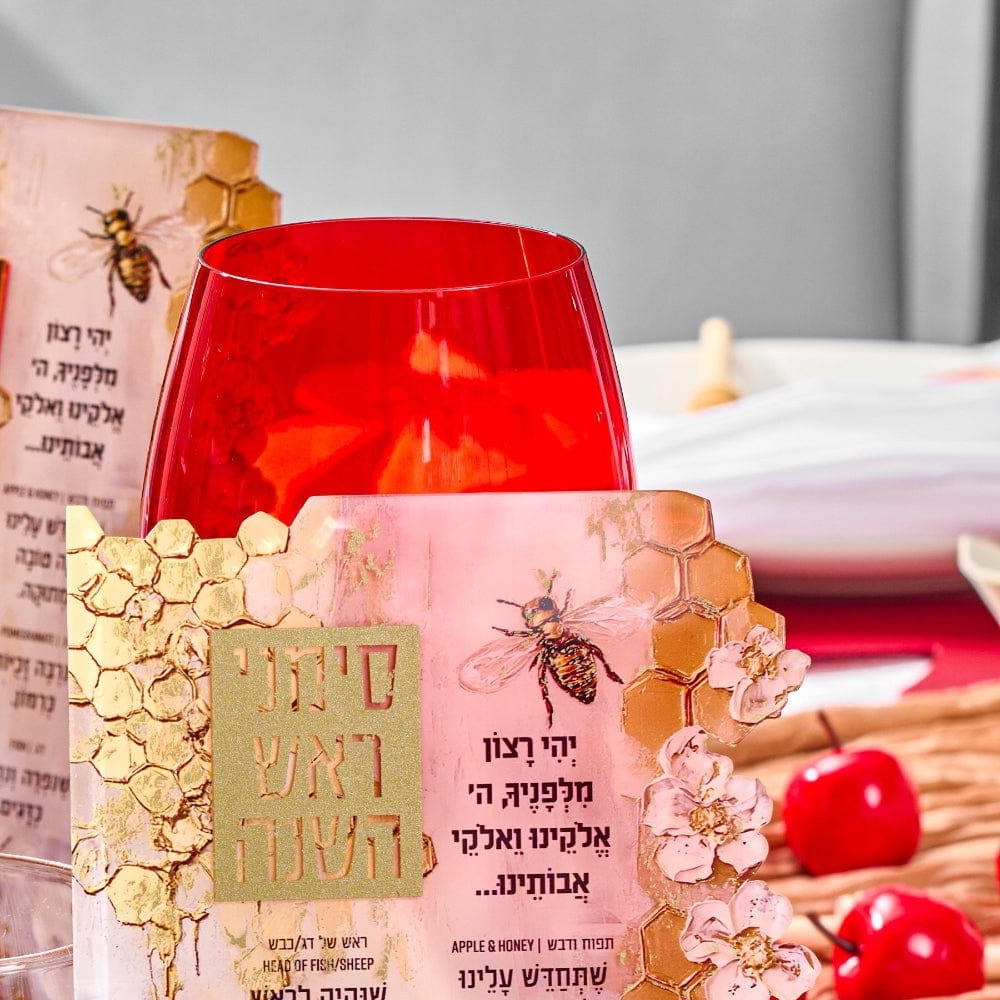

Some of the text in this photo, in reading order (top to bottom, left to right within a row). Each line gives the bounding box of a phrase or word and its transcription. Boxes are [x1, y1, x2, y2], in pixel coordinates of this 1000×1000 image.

[233, 644, 398, 712] סימני
[253, 733, 383, 799] ראש
[236, 814, 401, 883] השנה
[268, 935, 315, 952] דג/כבש
[341, 936, 368, 949] ראש
[452, 940, 485, 954] APPLE
[488, 939, 496, 953] &
[499, 938, 534, 953] HONEY
[547, 938, 577, 951] ודבש
[582, 937, 614, 950] תפוח
[263, 957, 374, 973] HEAD OF FISH/SHEEP
